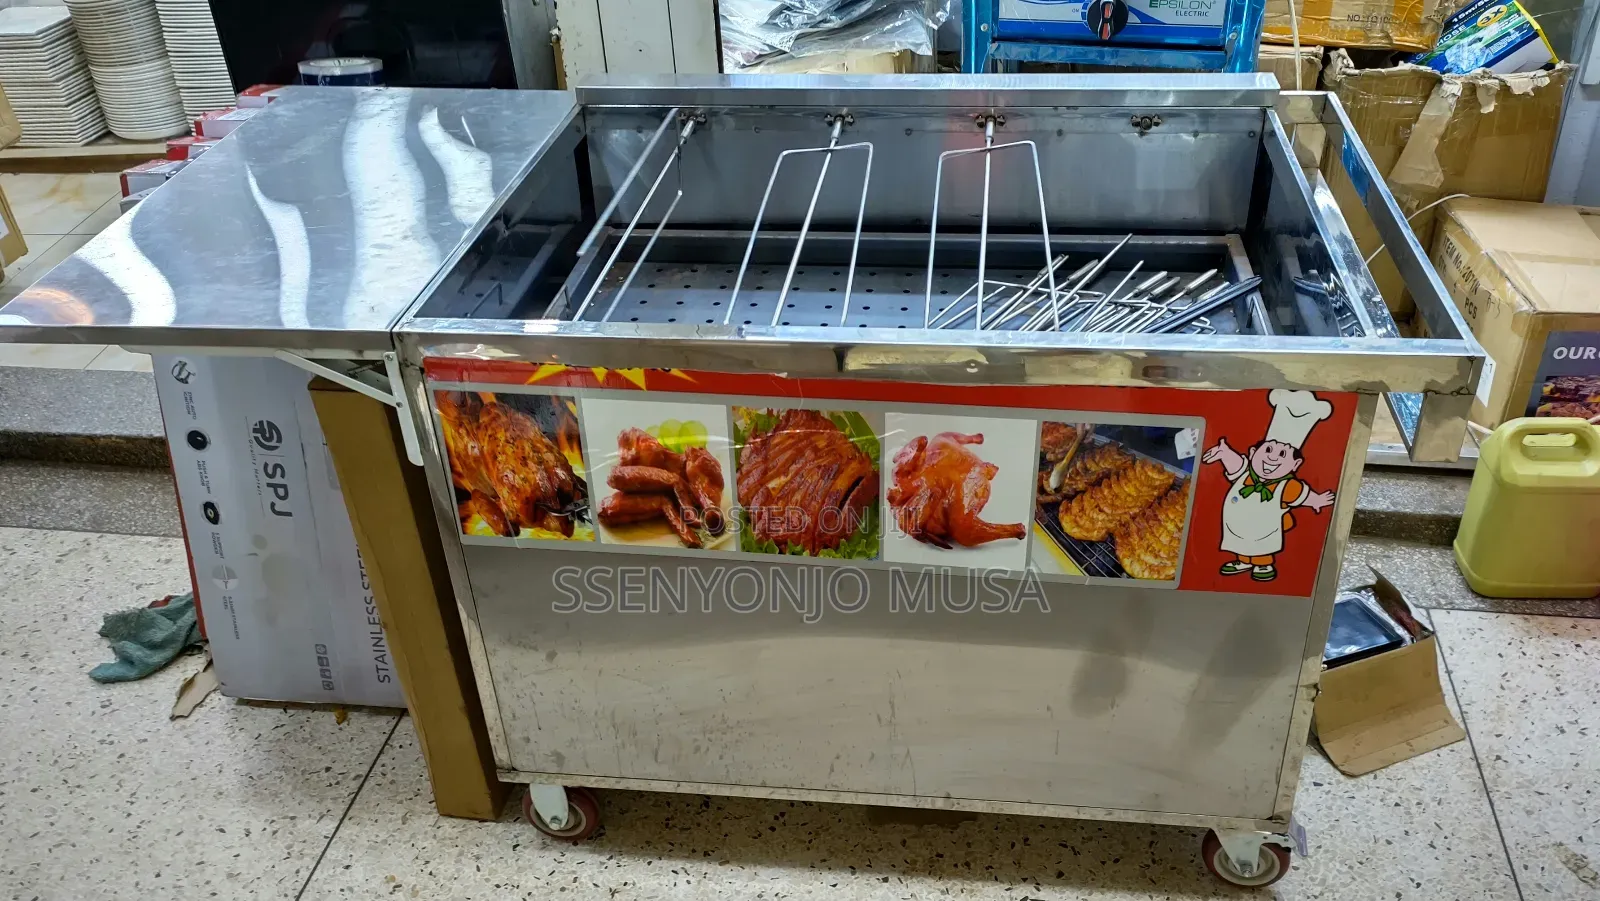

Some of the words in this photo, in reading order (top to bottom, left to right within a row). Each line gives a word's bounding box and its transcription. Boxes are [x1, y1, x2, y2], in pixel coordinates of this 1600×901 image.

[1149, 0, 1212, 9] EPSILON
[1442, 234, 1457, 259] ITEM
[1464, 297, 1478, 320] PCS
[248, 439, 257, 466] Quality
[253, 468, 262, 496] Matters
[263, 461, 293, 517] SPJ
[364, 595, 391, 684] STAINLESS
